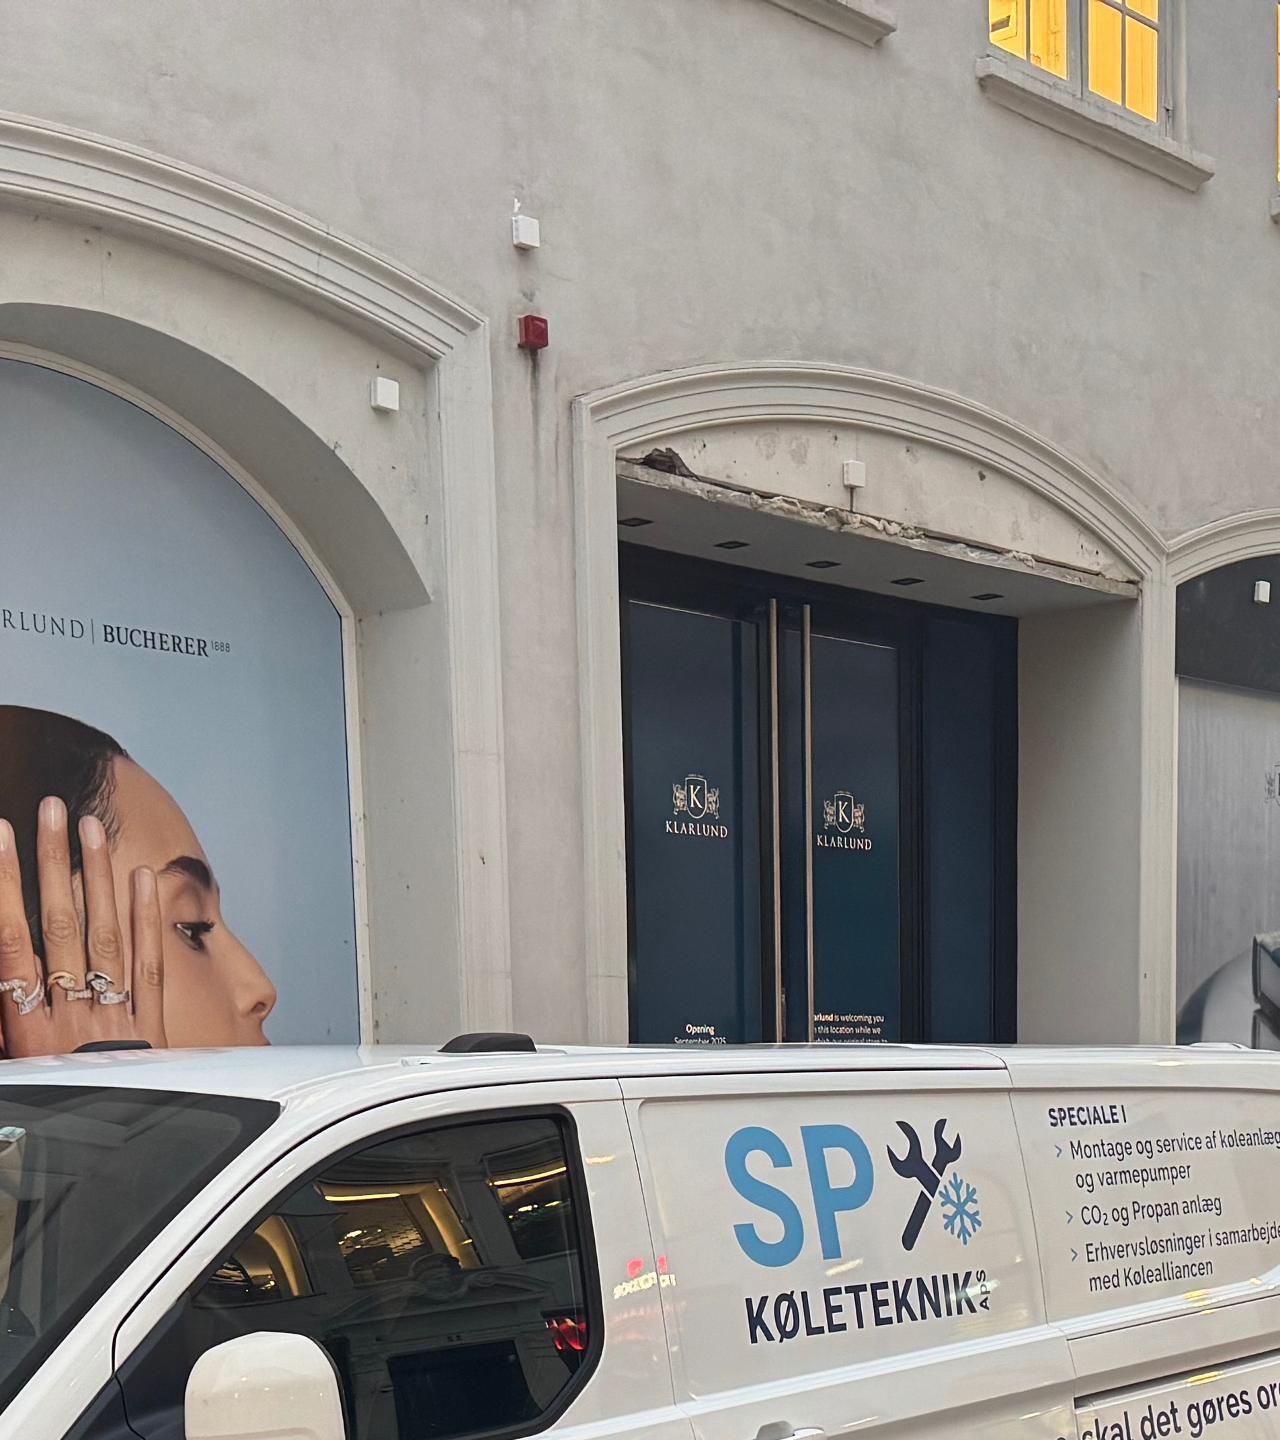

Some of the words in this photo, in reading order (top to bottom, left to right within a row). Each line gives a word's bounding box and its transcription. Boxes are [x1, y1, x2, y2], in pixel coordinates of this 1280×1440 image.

[103, 624, 209, 657] BUCHERER
[690, 784, 702, 809] K
[838, 801, 849, 823] K
[665, 820, 728, 838] KLARLUND
[816, 834, 872, 850] KLARLUND
[686, 1024, 714, 1035] Opening
[1049, 1105, 1119, 1127] SPECIALE
[1121, 1104, 1127, 1123] I
[1070, 1139, 1132, 1161] Montage
[1136, 1139, 1153, 1158] og
[1156, 1132, 1202, 1154] service
[1205, 1130, 1217, 1149] af
[1076, 1172, 1094, 1193] og
[1097, 1165, 1191, 1188] varmepumper
[724, 1124, 875, 1268] SP
[1112, 1206, 1129, 1226] og
[1132, 1200, 1179, 1221] Propan
[1182, 1195, 1222, 1215] anlæg
[1085, 1232, 1206, 1263] Erhvervsløsninger
[1089, 1271, 1120, 1292] med
[1123, 1260, 1213, 1287] Kølealliancen
[745, 1271, 977, 1344] KØLETEKNIK
[976, 1269, 991, 1310] APS
[1187, 1389, 1253, 1439] gøres
